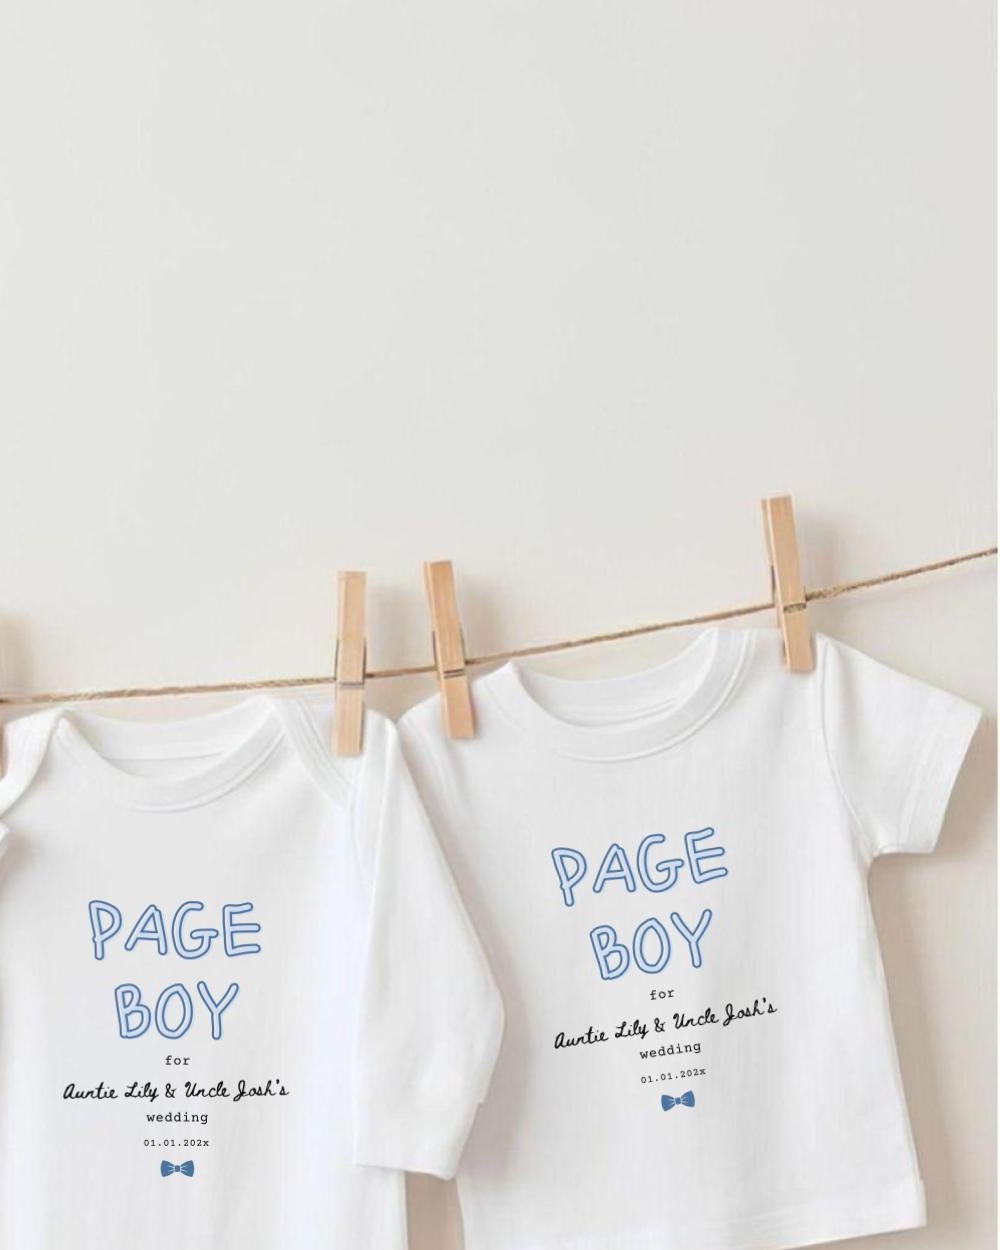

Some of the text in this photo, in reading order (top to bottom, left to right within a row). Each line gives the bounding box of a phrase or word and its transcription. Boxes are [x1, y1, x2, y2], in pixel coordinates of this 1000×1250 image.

[550, 826, 729, 908] PAGE
[88, 899, 262, 961] PAGE
[589, 908, 713, 981] BOY
[649, 988, 675, 1001] for
[113, 980, 240, 1041] BOY
[553, 996, 778, 1050] Auntie Lily & Uncle Josh's
[165, 1054, 190, 1066] for
[639, 1041, 701, 1060] wedding
[640, 1067, 707, 1084] 01.01.202x
[62, 1078, 290, 1103] Auntie Lily & Uncle Josh's
[146, 1111, 209, 1125] wedding
[143, 1139, 209, 1147] 01.01.202x
